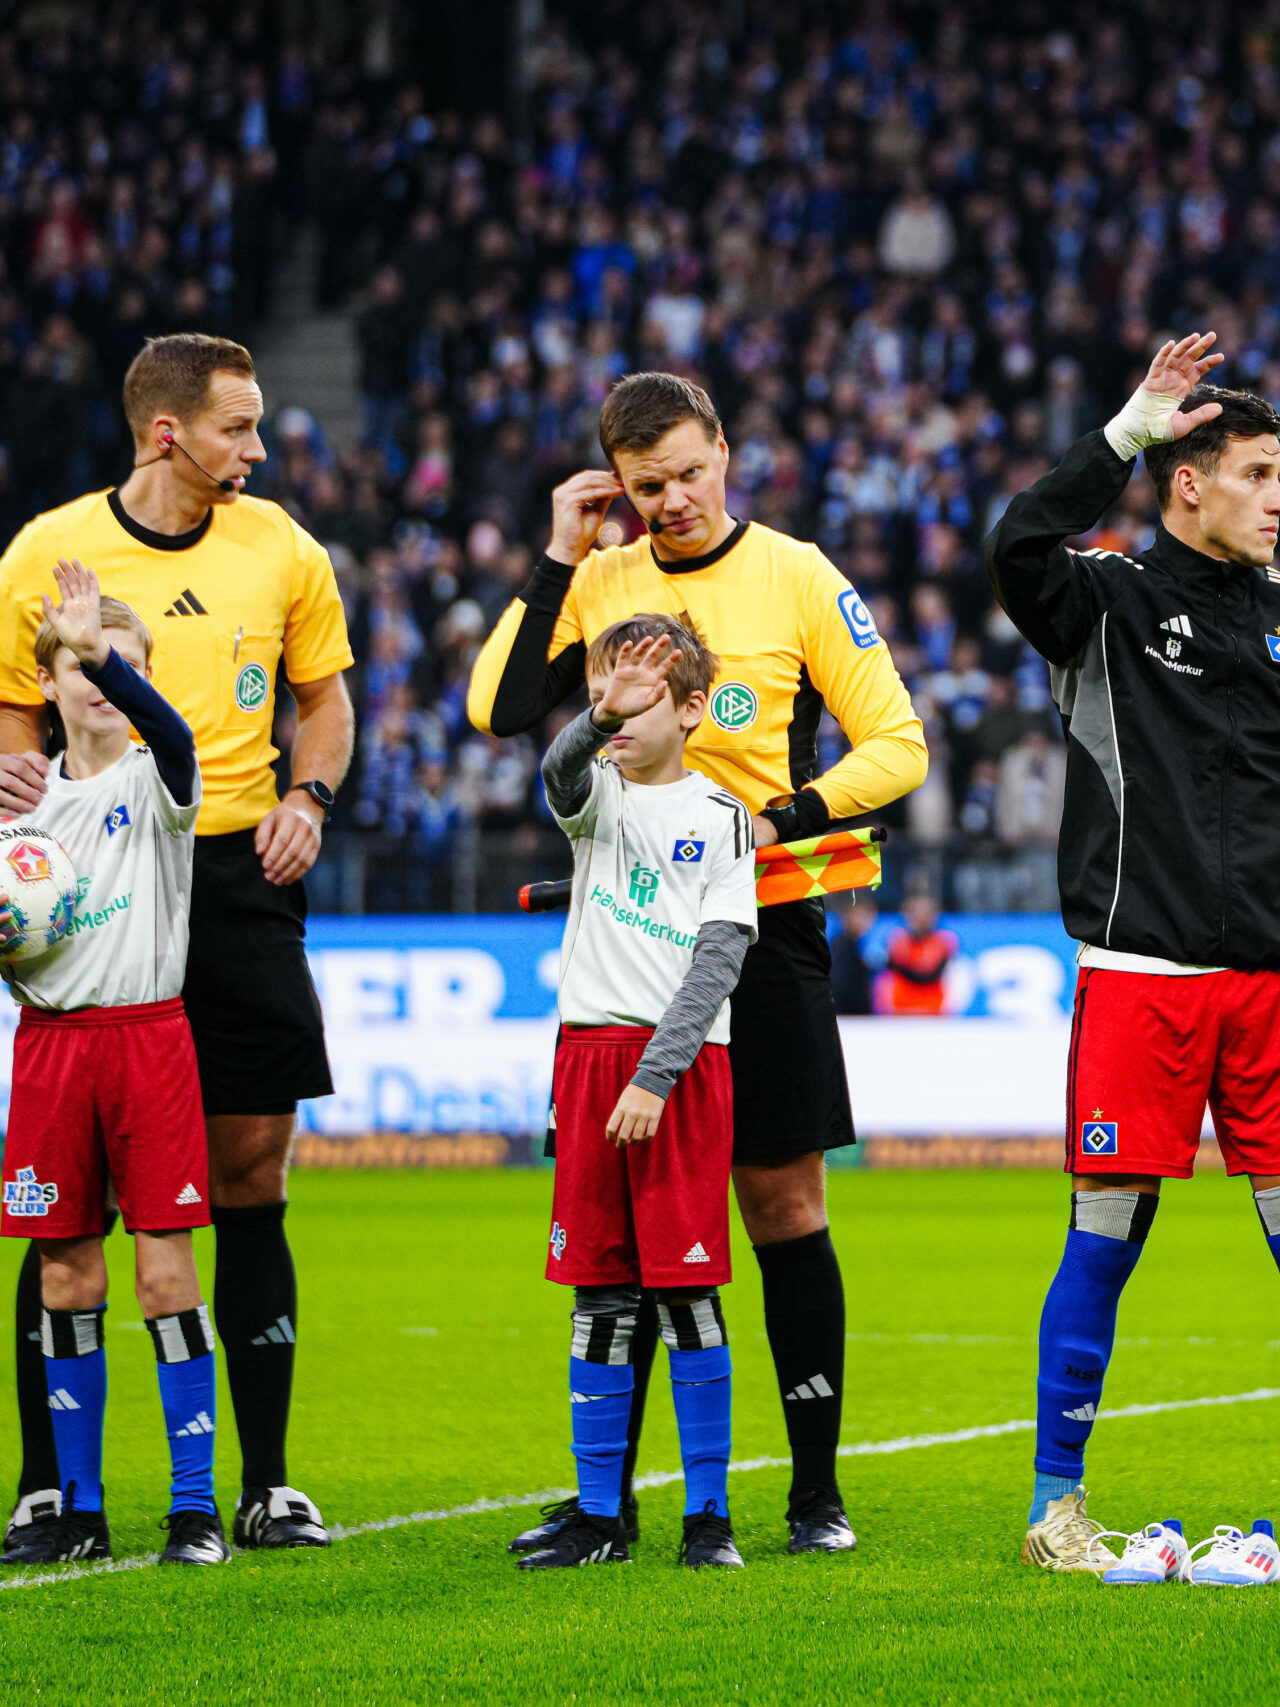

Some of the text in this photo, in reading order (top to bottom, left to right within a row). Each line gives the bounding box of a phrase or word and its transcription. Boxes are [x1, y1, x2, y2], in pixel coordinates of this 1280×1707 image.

[0, 826, 54, 842] DERBYS
[5, 1183, 56, 1203] KIDS
[10, 1202, 48, 1214] CLUB
